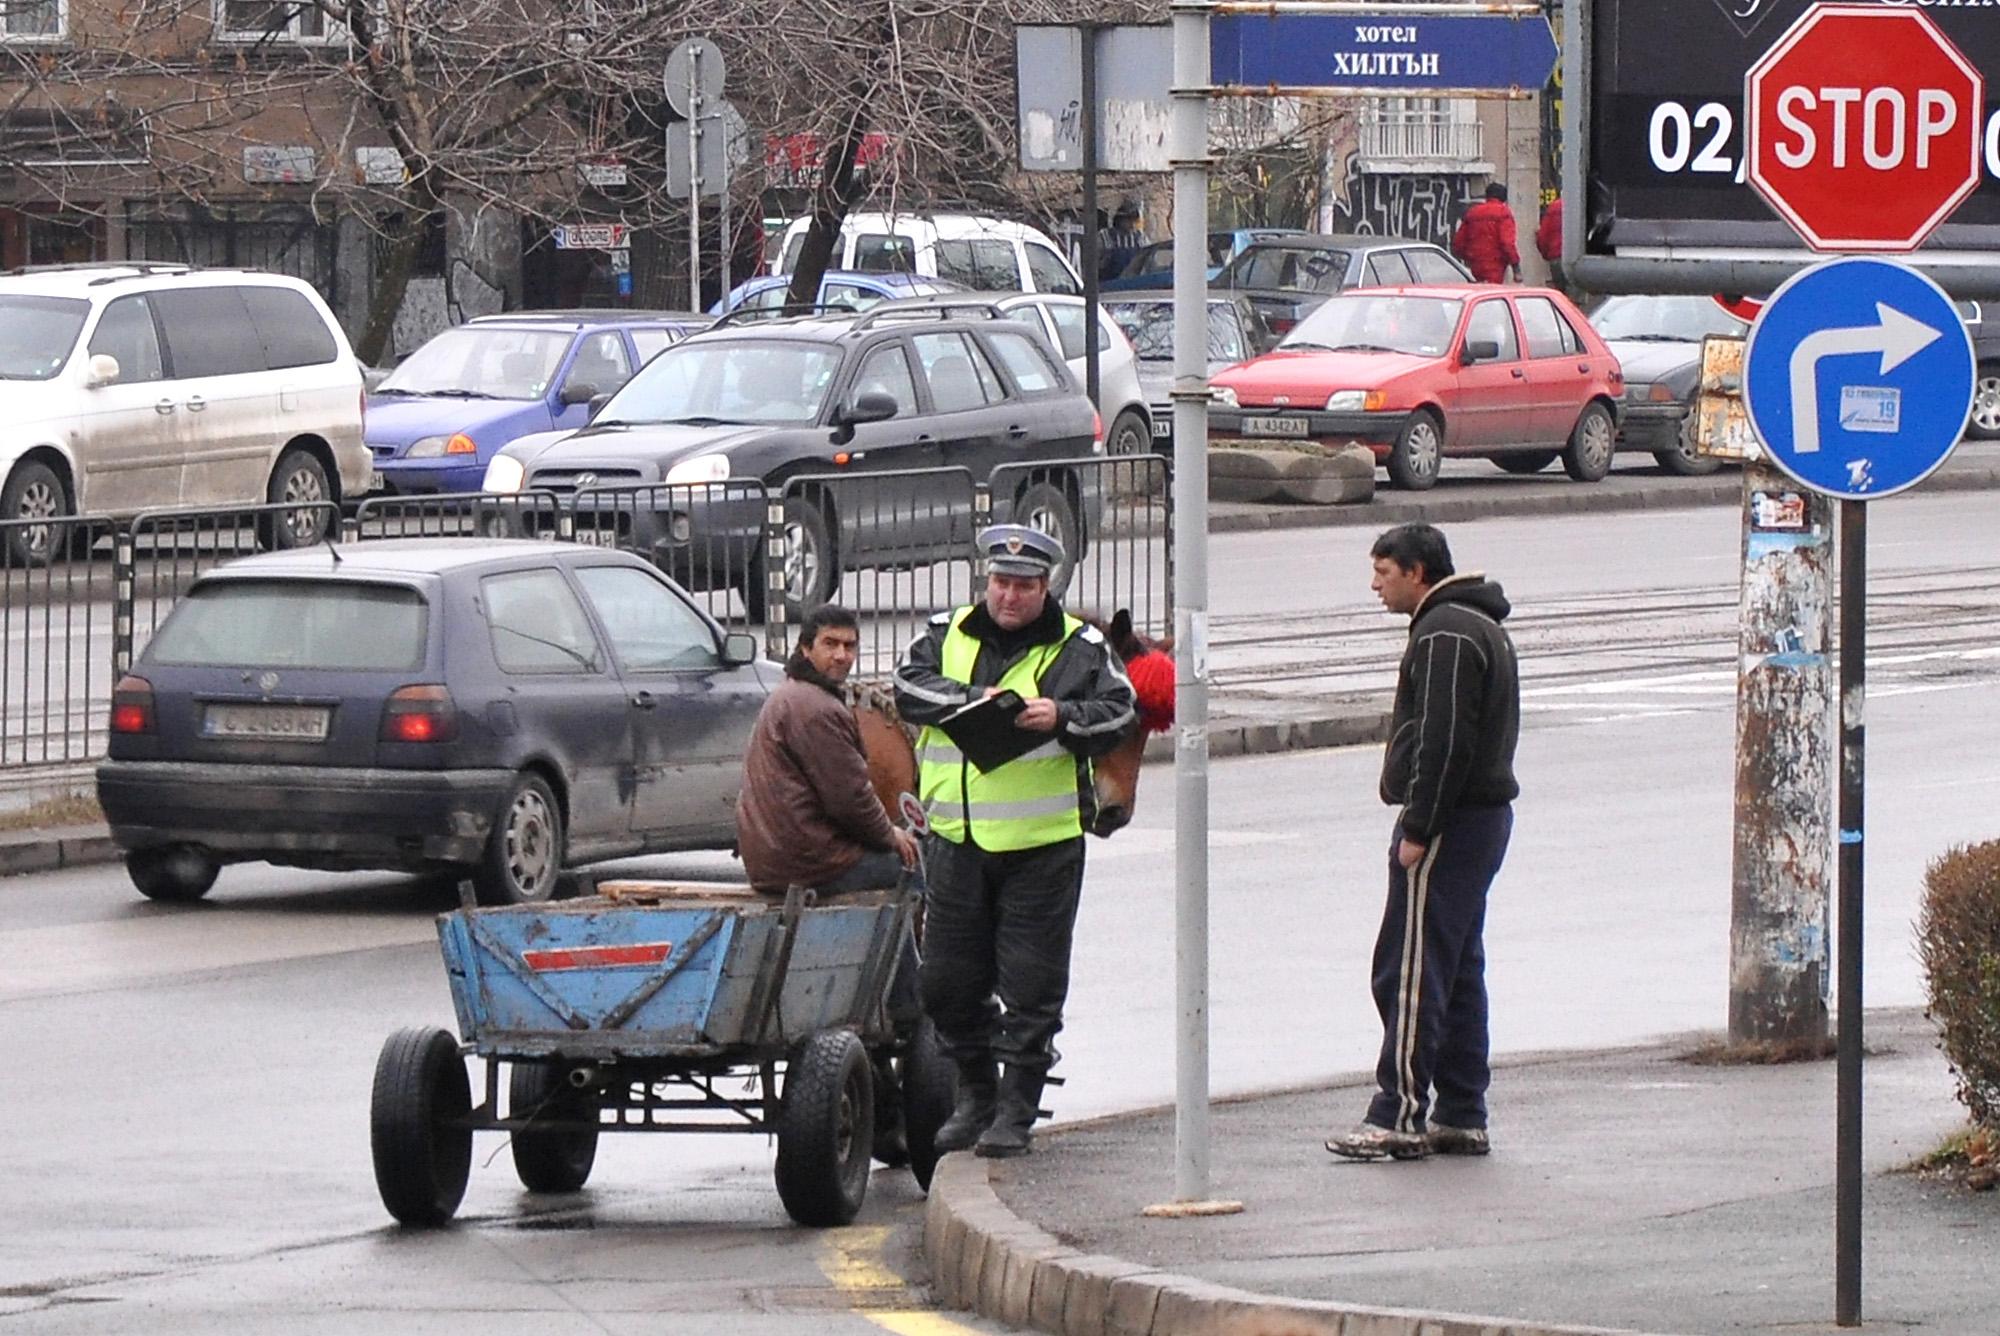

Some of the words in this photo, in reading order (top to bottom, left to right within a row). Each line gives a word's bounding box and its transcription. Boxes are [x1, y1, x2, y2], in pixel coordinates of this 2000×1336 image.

[1355, 26, 1417, 42] хотел
[1333, 53, 1440, 75] ХИЛТЪН
[1774, 86, 1958, 170] STOP
[1879, 401, 1896, 418] 19
